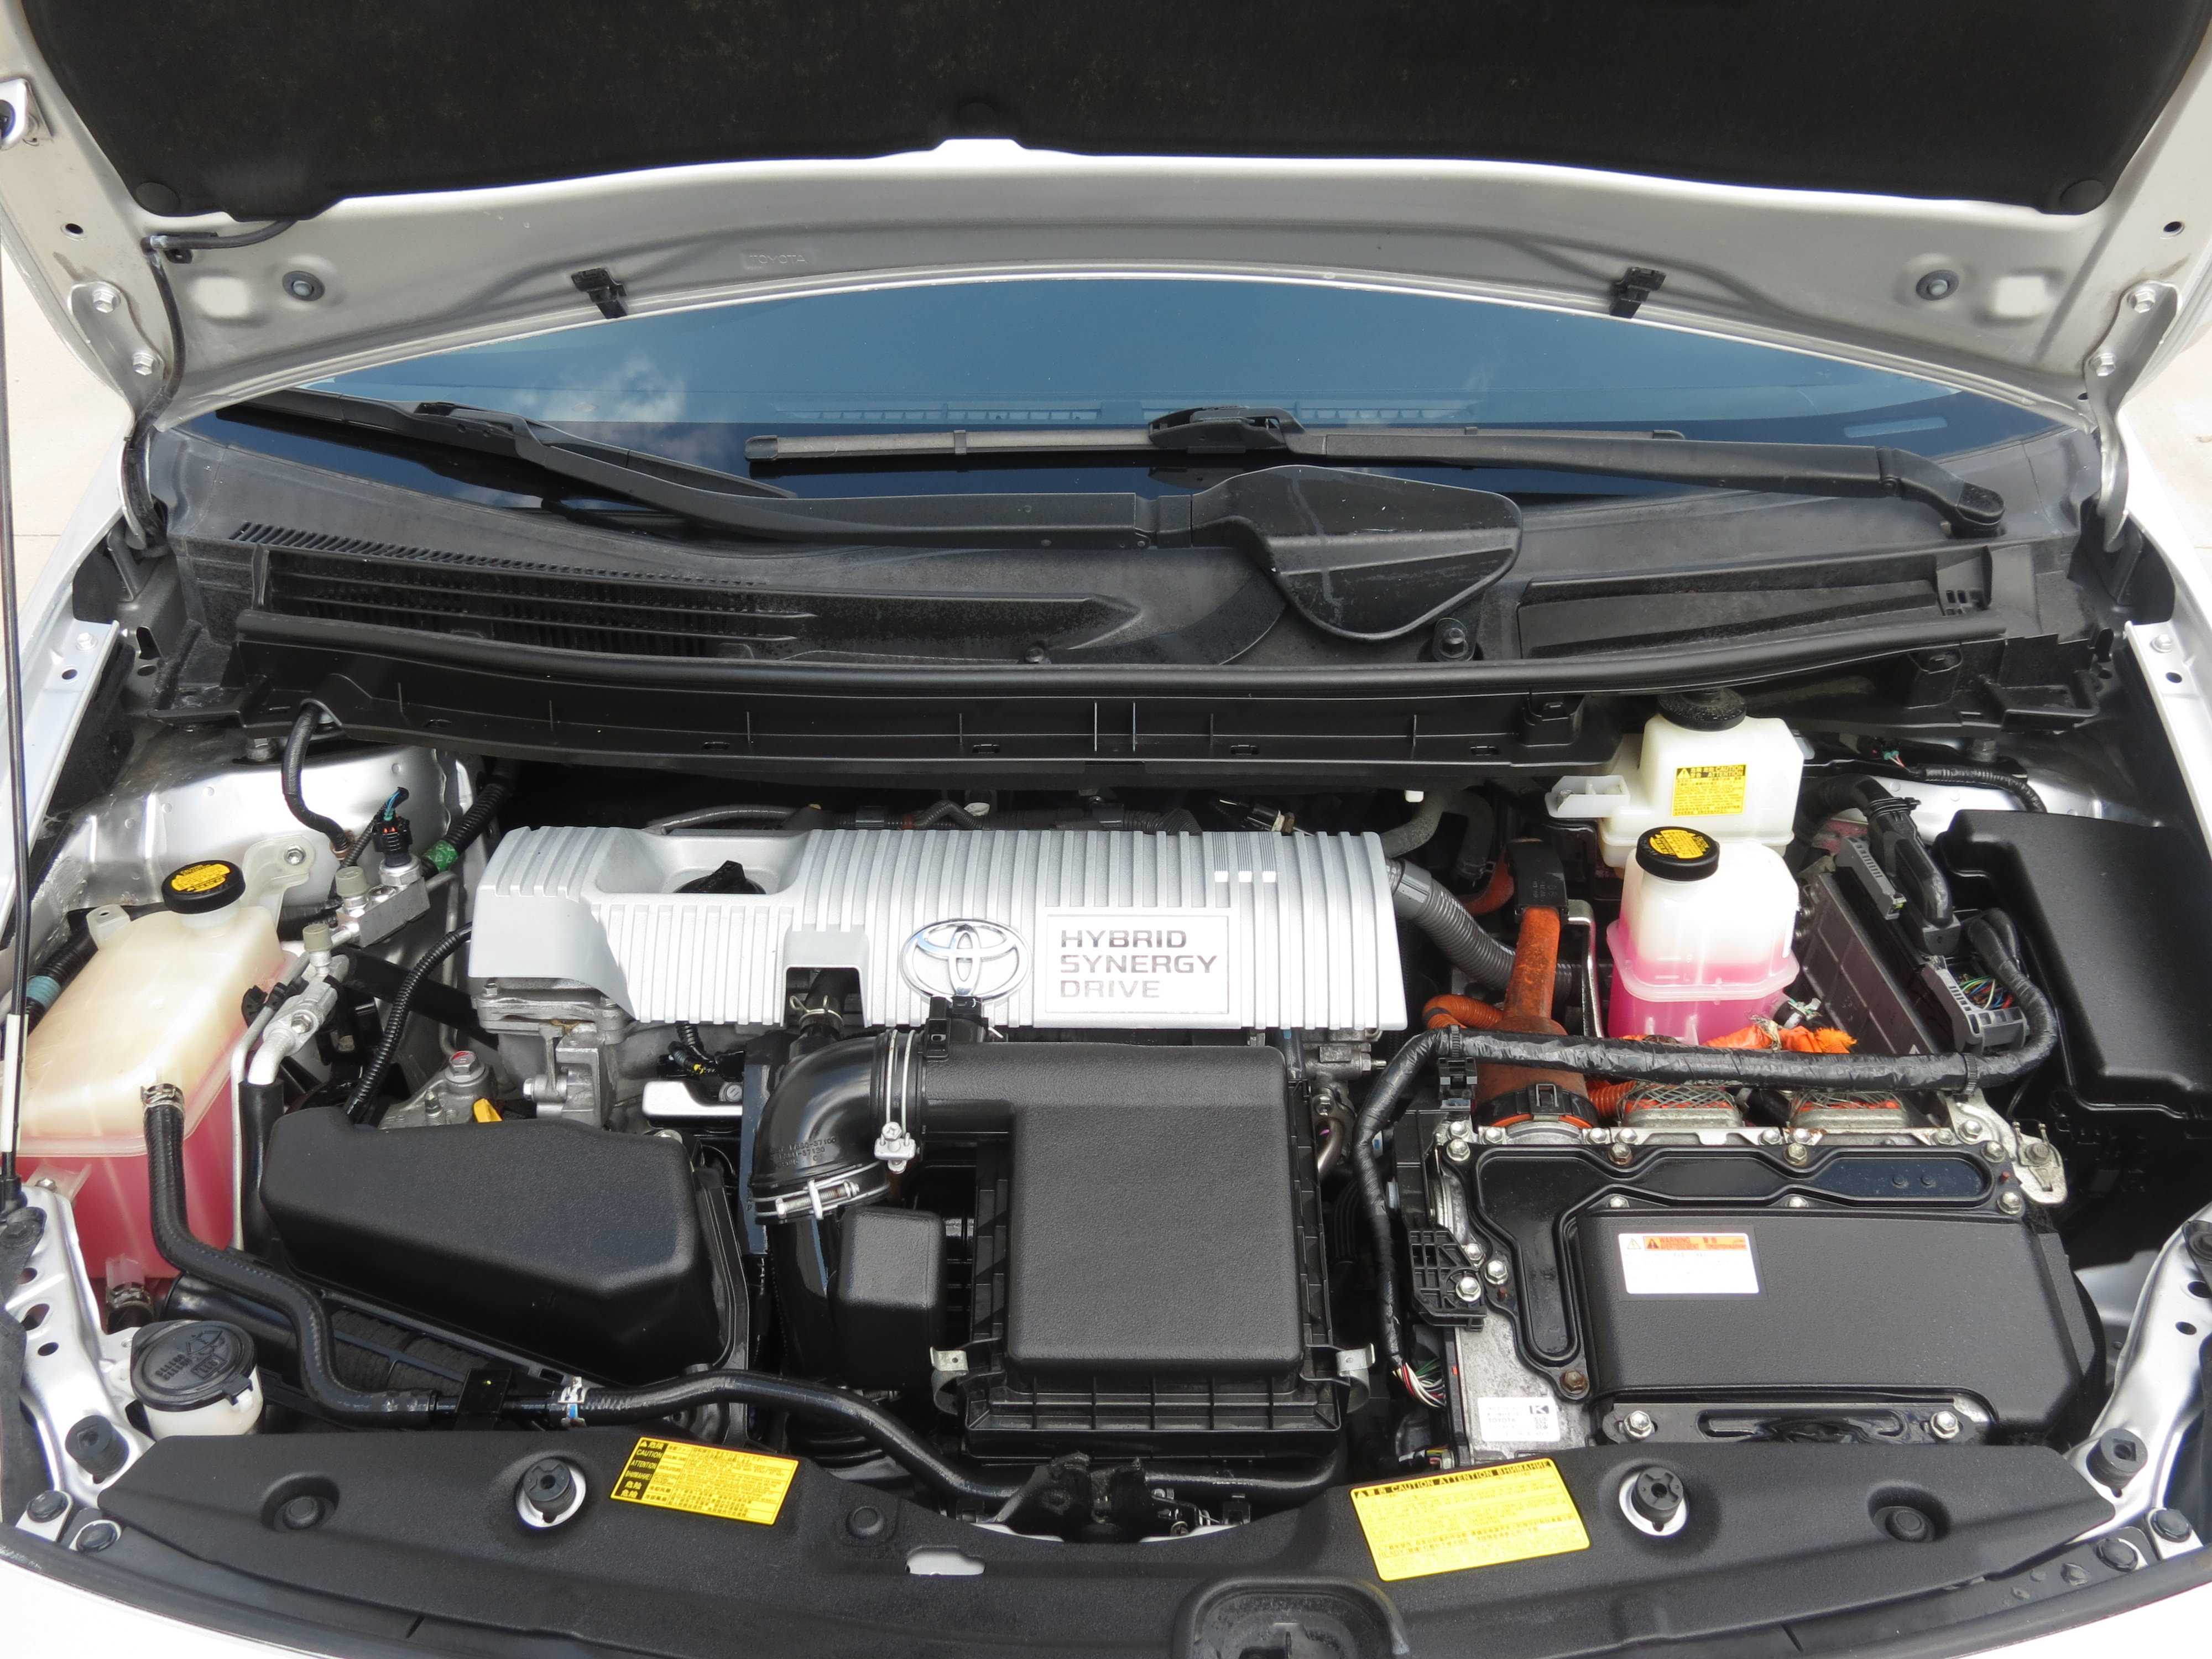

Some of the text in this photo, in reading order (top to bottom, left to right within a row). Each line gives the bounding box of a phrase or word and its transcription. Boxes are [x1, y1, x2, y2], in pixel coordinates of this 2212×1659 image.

[749, 254, 808, 264] TOYOTA
[1060, 930, 1187, 948] HYBRID
[1060, 954, 1218, 974] SYNERGY
[1060, 980, 1160, 999] DRIVE
[636, 1449, 664, 1459] CAUTION
[630, 1459, 658, 1469] ATTENTION
[1391, 1479, 1434, 1493] CAUTION
[1439, 1469, 1493, 1485] ATTENTION
[1497, 1460, 1548, 1477] ВНИМАНИЕ
